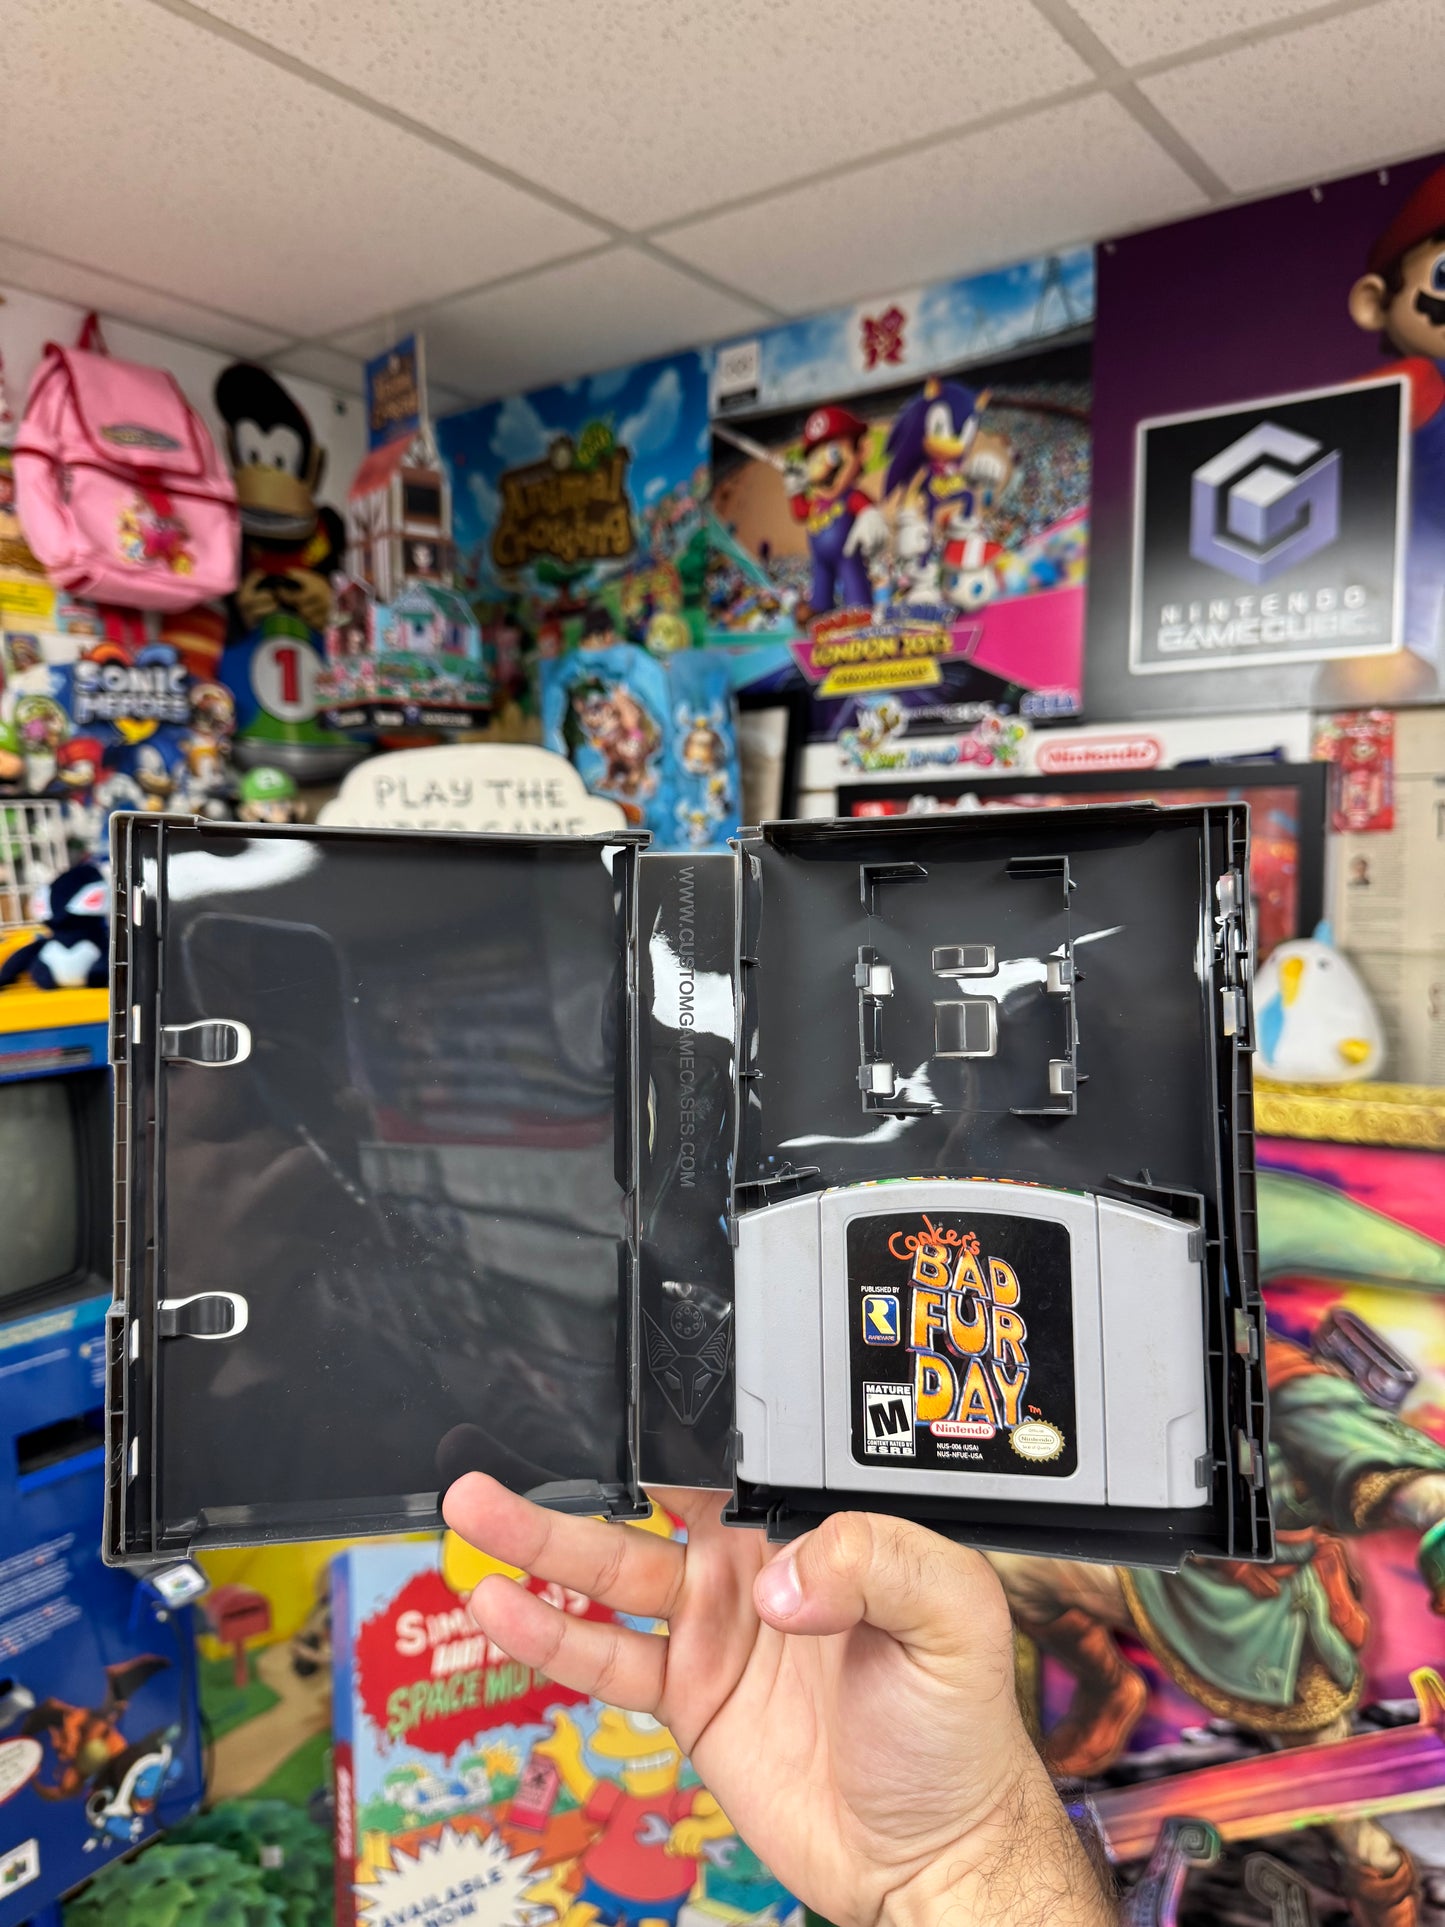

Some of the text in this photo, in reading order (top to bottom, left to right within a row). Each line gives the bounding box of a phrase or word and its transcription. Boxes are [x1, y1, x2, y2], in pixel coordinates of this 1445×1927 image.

[1160, 584, 1367, 625] NINTENDO
[1157, 609, 1371, 653] GAMECUBE
[811, 637, 898, 668] LONDON
[75, 661, 188, 693] SONIC
[374, 775, 567, 810] PLAY THE
[678, 865, 695, 1188] WWW.CUSTOMGAMECASES.COM
[888, 1214, 981, 1260] Conker's
[860, 1285, 900, 1294] PUBLISHED BY
[911, 1243, 1021, 1308] BAD
[909, 1287, 1030, 1367] FUR
[866, 1384, 911, 1395] MATURE
[914, 1351, 1030, 1430] DAY
[868, 1398, 911, 1438] M
[935, 1423, 990, 1435] Nintendo
[866, 1445, 913, 1454] ESRB
[936, 1442, 979, 1451] NUS-006 (USA)
[936, 1451, 984, 1460] NUS-NFUE-USA
[386, 1668, 484, 1740] SPACE
[379, 1865, 504, 1926] AVAILABLE
[424, 1901, 476, 1927] NOW
